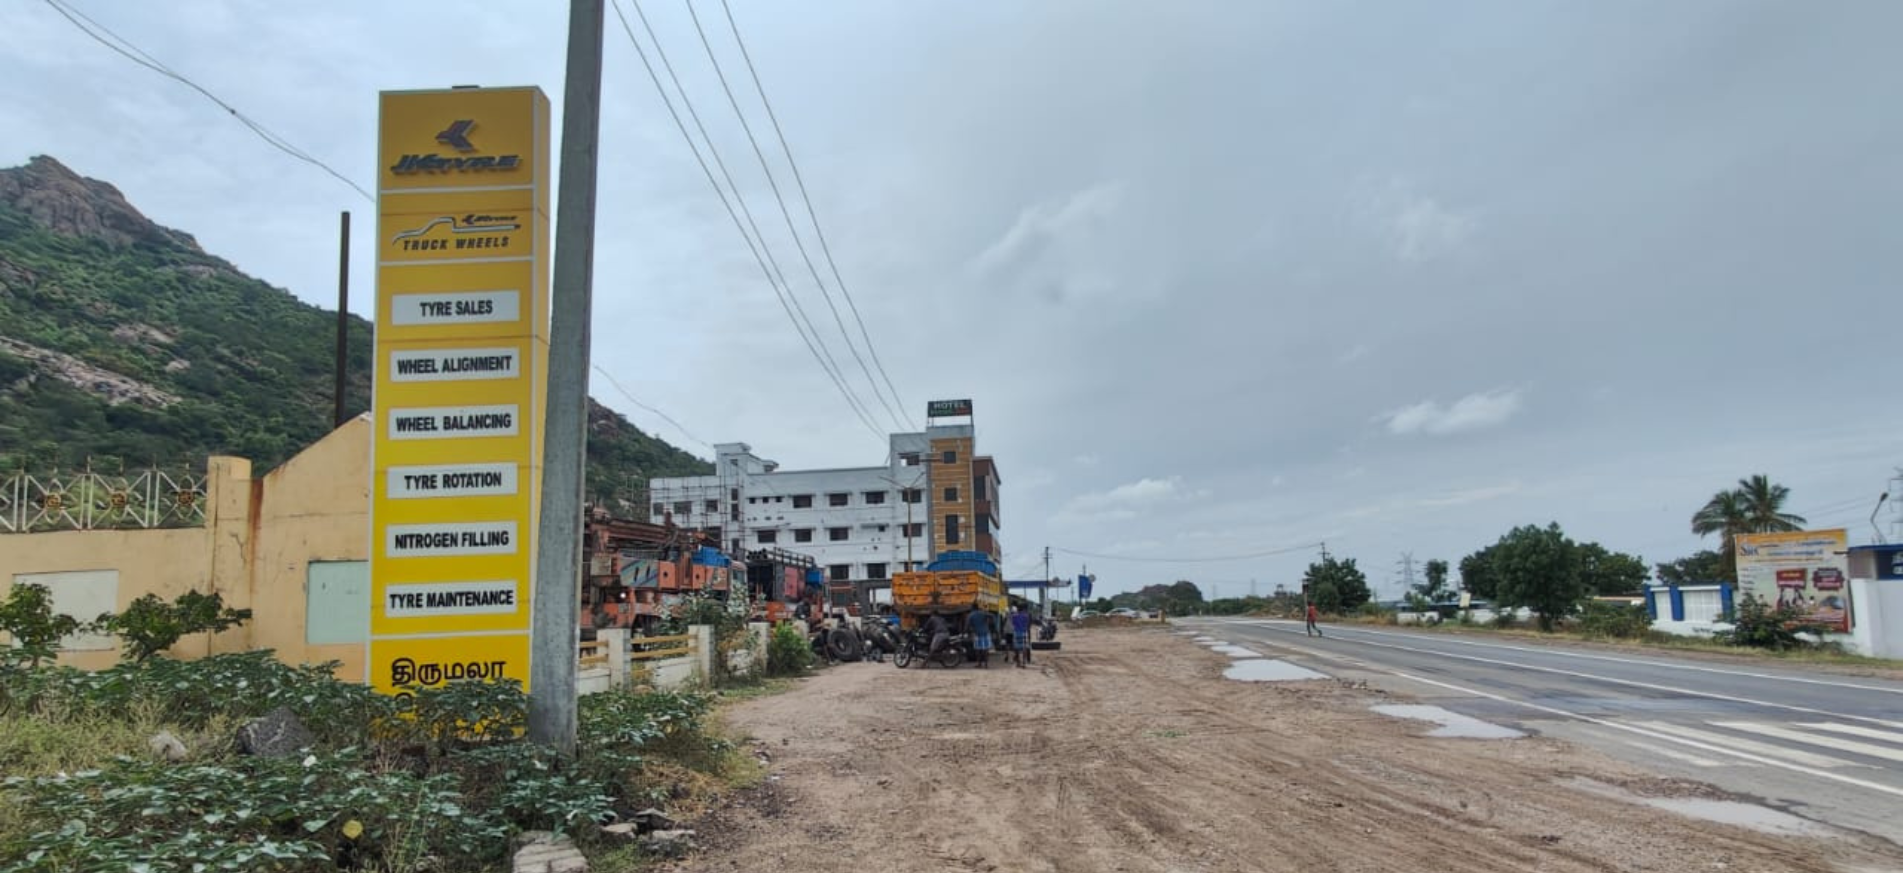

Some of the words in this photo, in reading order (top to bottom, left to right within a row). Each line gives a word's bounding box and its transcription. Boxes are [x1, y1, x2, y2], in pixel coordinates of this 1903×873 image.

[403, 239, 448, 251] TRUCK
[456, 236, 510, 249] WHEELS
[419, 301, 452, 317] TYRE
[455, 300, 493, 315] SALES
[397, 358, 439, 375] WHEEL
[441, 355, 512, 373] ALIGNMENT
[396, 416, 438, 432] WHEEL
[443, 413, 511, 430] BALANCING
[404, 474, 437, 490] TYRE
[443, 472, 502, 488] ROTATION
[395, 532, 458, 549] NITROGEN
[462, 530, 509, 547] FILLING
[389, 593, 423, 609] TYRE
[426, 590, 514, 607] MAINTENANCE
[391, 657, 506, 687] திருமலா
